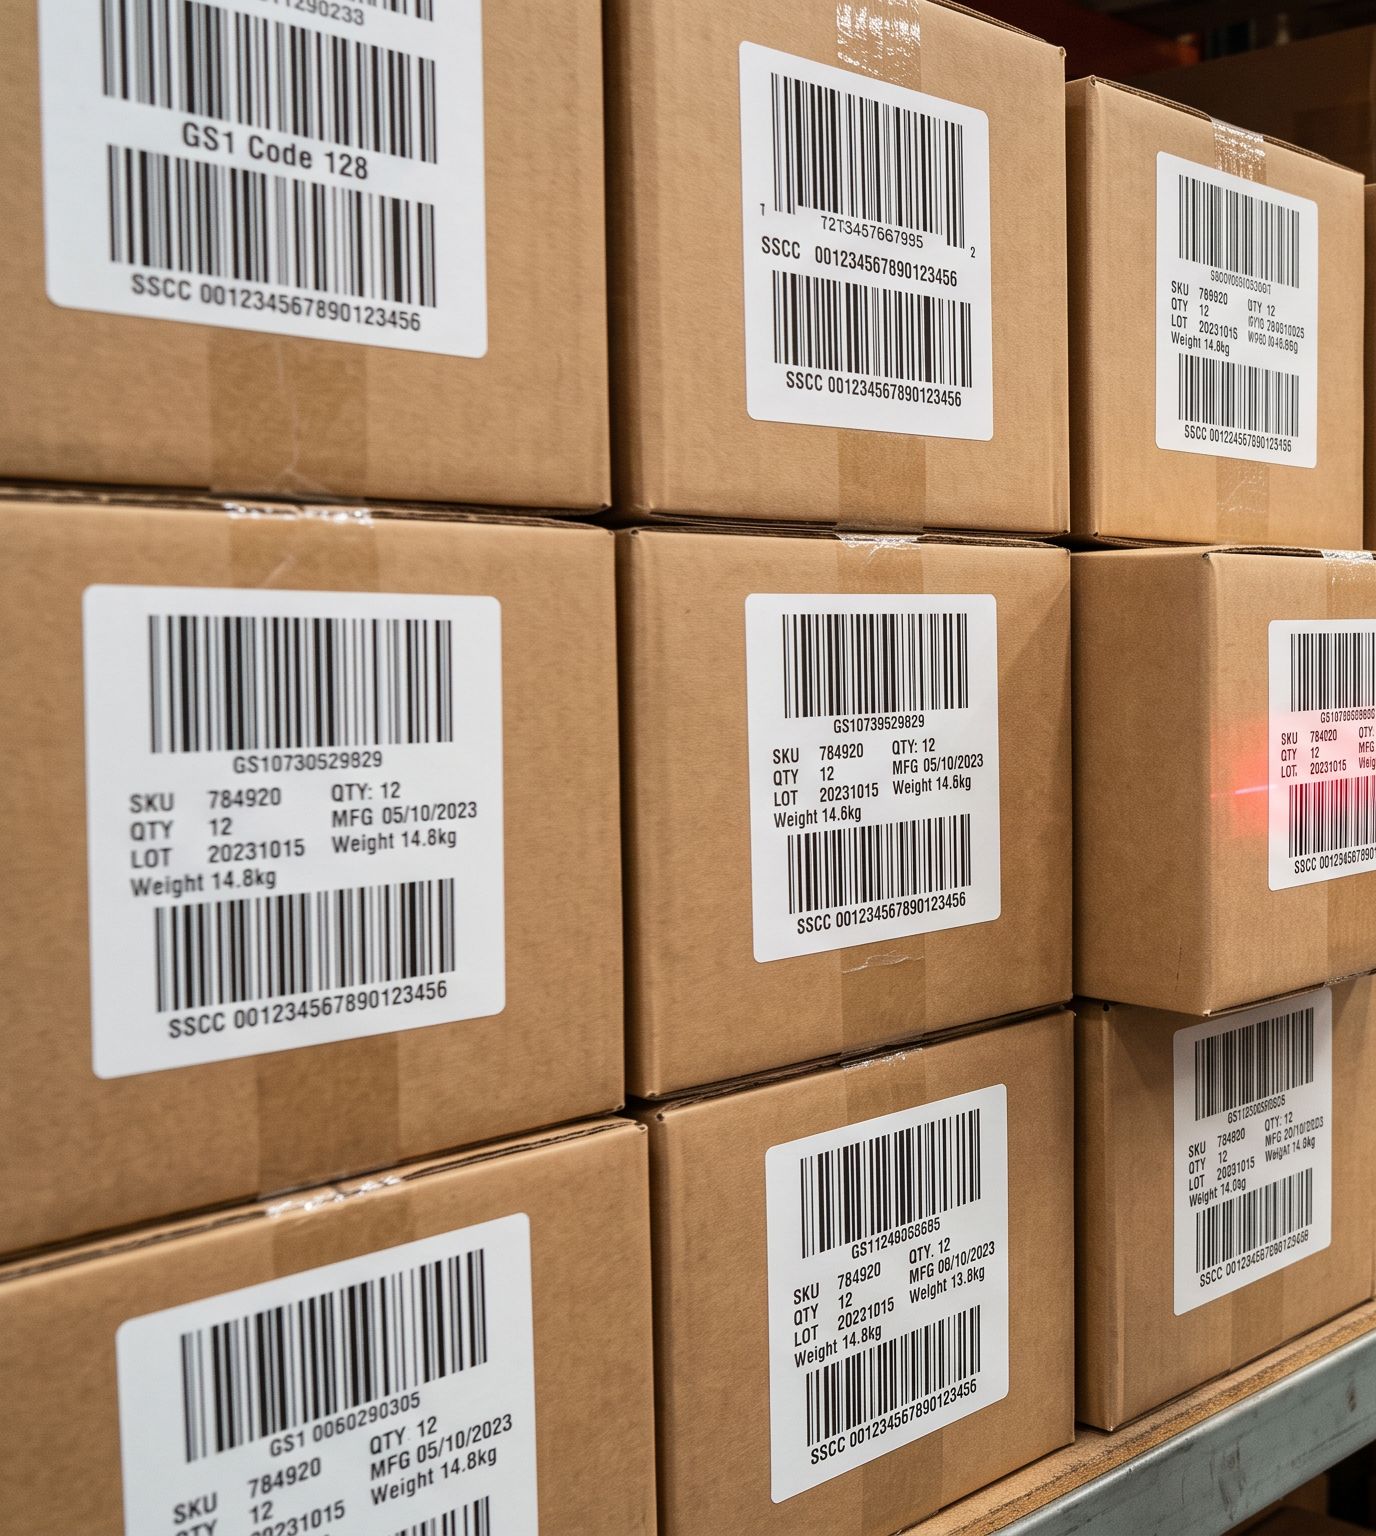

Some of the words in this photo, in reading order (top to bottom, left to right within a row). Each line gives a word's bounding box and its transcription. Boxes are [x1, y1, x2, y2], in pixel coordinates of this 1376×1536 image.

[182, 121, 235, 154] GS1
[248, 136, 312, 169] Code
[324, 151, 368, 180] 128
[762, 236, 800, 259] SSCC
[815, 246, 957, 287] 001234567890123456
[971, 247, 976, 258] 2
[1171, 280, 1189, 296] SKU
[132, 274, 191, 300] SSCC
[200, 282, 420, 332] 001234567890123456
[1199, 304, 1209, 317] 12
[1267, 305, 1275, 317] 12
[1171, 314, 1188, 329] LOT
[786, 371, 823, 392] SSCC
[828, 378, 962, 407] 001234567890123456
[1184, 425, 1207, 440] SSCC
[892, 739, 918, 755] QTY:
[922, 738, 935, 753] 12
[1281, 732, 1298, 745] SKU
[233, 751, 382, 774] GS10730529829
[772, 748, 800, 765] SKU
[819, 743, 864, 761] 784920
[893, 760, 918, 775] MFG
[923, 753, 984, 773] 05/10/2023
[1281, 748, 1297, 762] QTY
[1310, 747, 1320, 759] 12
[773, 769, 799, 786] QTY
[820, 766, 834, 781] 12
[1310, 759, 1347, 775] 20231015
[331, 783, 372, 802] QTY:
[380, 781, 401, 800] 12
[774, 790, 798, 807] LOT
[819, 782, 879, 803] 20231015
[893, 778, 932, 796] Weight
[129, 792, 175, 814] SKU
[207, 787, 281, 809] 784920
[331, 809, 372, 828] MFG
[382, 801, 477, 824] 05/10/2023
[774, 809, 818, 829] Weight
[130, 820, 174, 842] QTY
[210, 817, 233, 836] 12
[131, 848, 172, 869] LOT
[208, 839, 305, 864] 20231015
[331, 833, 394, 856] Weight
[401, 828, 457, 849] 14.8kg
[1294, 857, 1317, 874] SSCC
[130, 875, 203, 898] Weight
[212, 869, 276, 890] 14.8kg
[797, 914, 831, 935] SSCC
[836, 891, 966, 928] 001234567890123456
[169, 1012, 225, 1039] SSCC
[234, 980, 447, 1029] 001234567890123456
[1285, 1111, 1293, 1124] 12
[1188, 1140, 1206, 1158] SKU
[1265, 1131, 1281, 1147] MFG
[1218, 1150, 1228, 1164] 12
[1189, 1174, 1205, 1192] LOT
[938, 1237, 950, 1253] 12
[909, 1263, 934, 1285] MFG
[938, 1241, 995, 1274] 08/10/2023
[793, 1282, 820, 1305] SKU
[837, 1261, 881, 1290] 784920
[909, 1279, 947, 1304] Weight
[951, 1266, 985, 1289] 13.8kg
[1200, 1266, 1223, 1288] SSCC
[794, 1303, 819, 1327] QTY
[838, 1292, 853, 1310] 12
[794, 1325, 819, 1348] LOT
[794, 1339, 838, 1368] Weight
[842, 1326, 882, 1350] 14.8kg
[270, 1431, 306, 1458] GS1
[313, 1391, 420, 1443] 0060290305
[811, 1436, 845, 1465] SSCC
[850, 1378, 977, 1448] 001234567890123456
[370, 1426, 407, 1456] QTY
[417, 1416, 438, 1438] 12
[370, 1452, 410, 1481] MFG
[417, 1414, 512, 1464] 05/10/2023
[370, 1473, 434, 1506] Weight
[441, 1447, 497, 1479] 14.8kg
[173, 1492, 218, 1525] SKU
[247, 1457, 321, 1499] 784920
[175, 1518, 218, 1536] TY
[249, 1501, 274, 1524] 12
[250, 1500, 345, 1536] 231015
